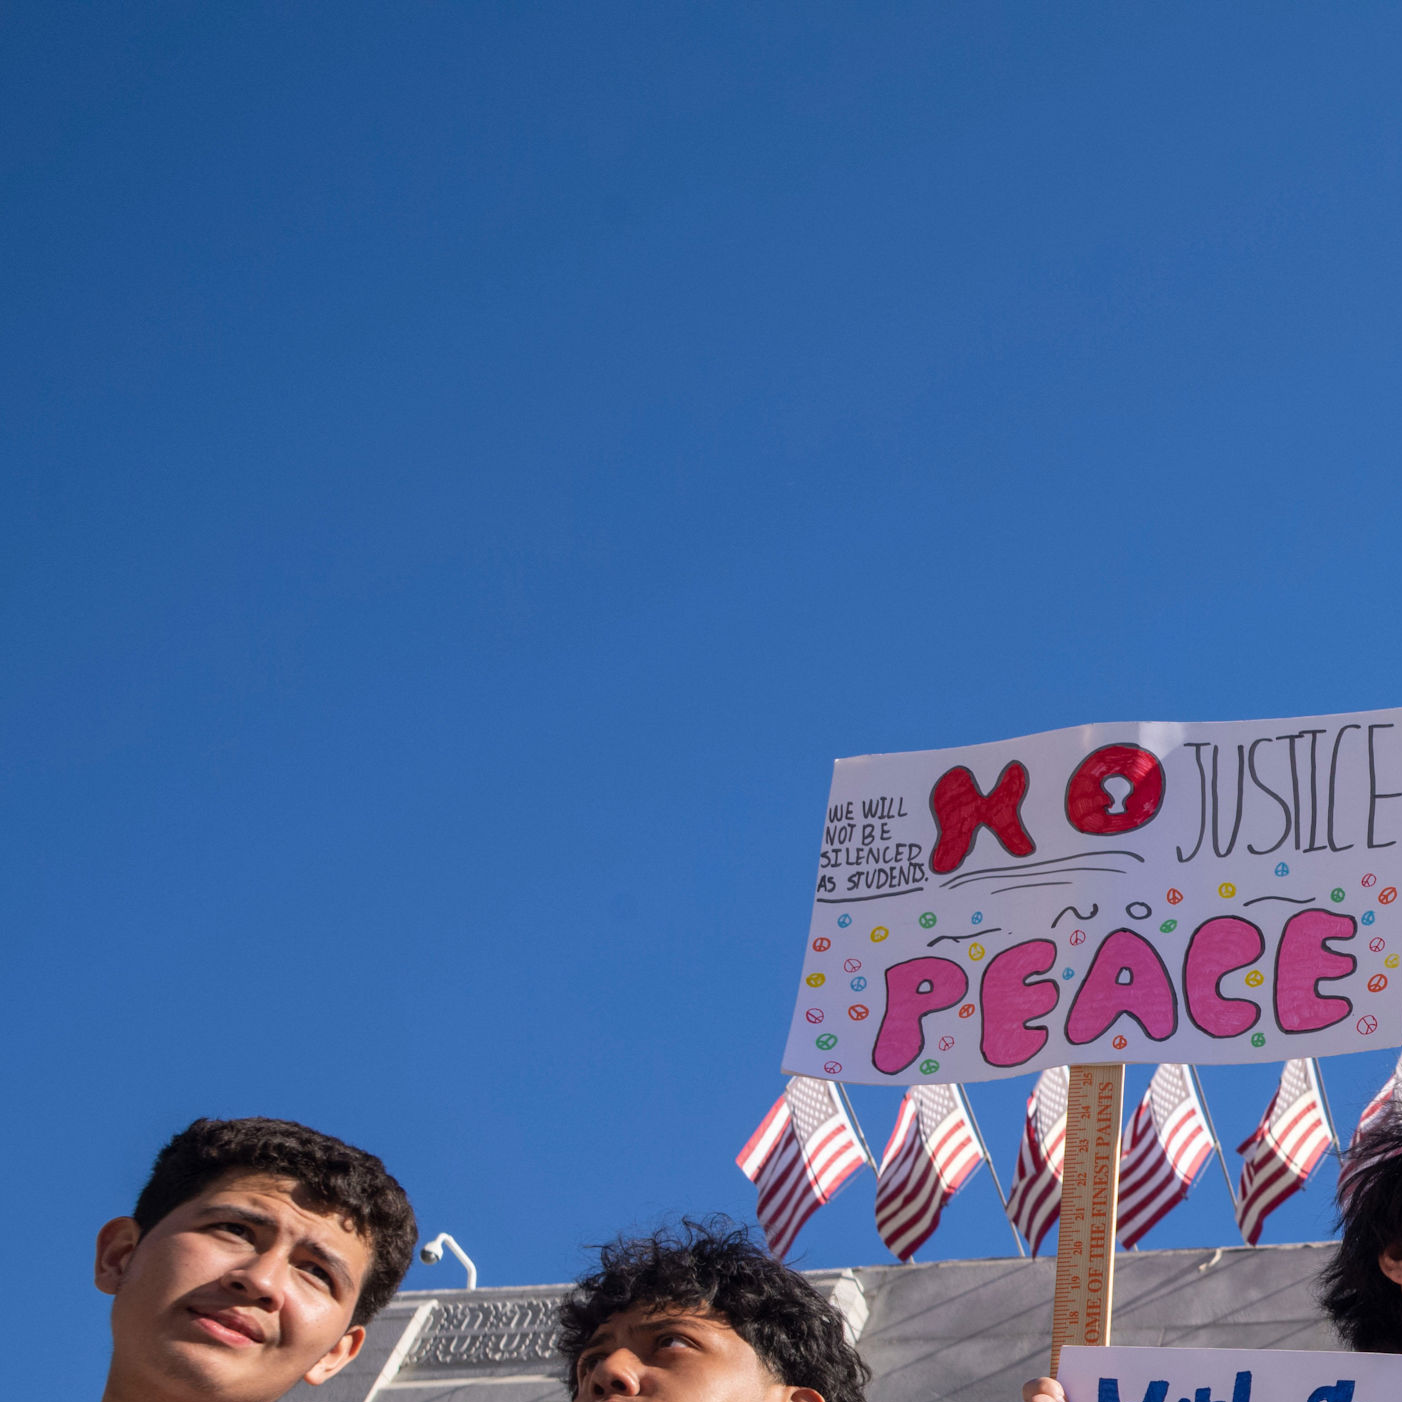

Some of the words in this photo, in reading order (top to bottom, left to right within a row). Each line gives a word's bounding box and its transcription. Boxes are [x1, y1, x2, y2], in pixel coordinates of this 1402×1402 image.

[828, 801, 855, 823] WE
[862, 796, 908, 820] WILL
[929, 742, 1167, 875] NO
[1176, 724, 1402, 863] JUSTICE
[826, 823, 856, 846] NOT
[861, 822, 892, 846] BE
[820, 843, 922, 868] SILENCED
[817, 874, 836, 893] AS
[847, 862, 928, 891] STUDENTS.
[871, 908, 1358, 1075] PEACE
[1083, 1072, 1093, 1087] 25
[1081, 1105, 1091, 1119] 24
[1095, 1081, 1113, 1149] PAINTS
[1079, 1138, 1088, 1153] 23
[1077, 1172, 1087, 1187] 22
[1091, 1153, 1110, 1218] FINEST
[1075, 1207, 1085, 1221] 21
[1073, 1241, 1082, 1256] 20
[1089, 1223, 1106, 1262] THE
[1071, 1275, 1081, 1290] 19
[1087, 1268, 1104, 1293] OF
[1069, 1310, 1079, 1325] 18
[1084, 1297, 1101, 1348] OME
